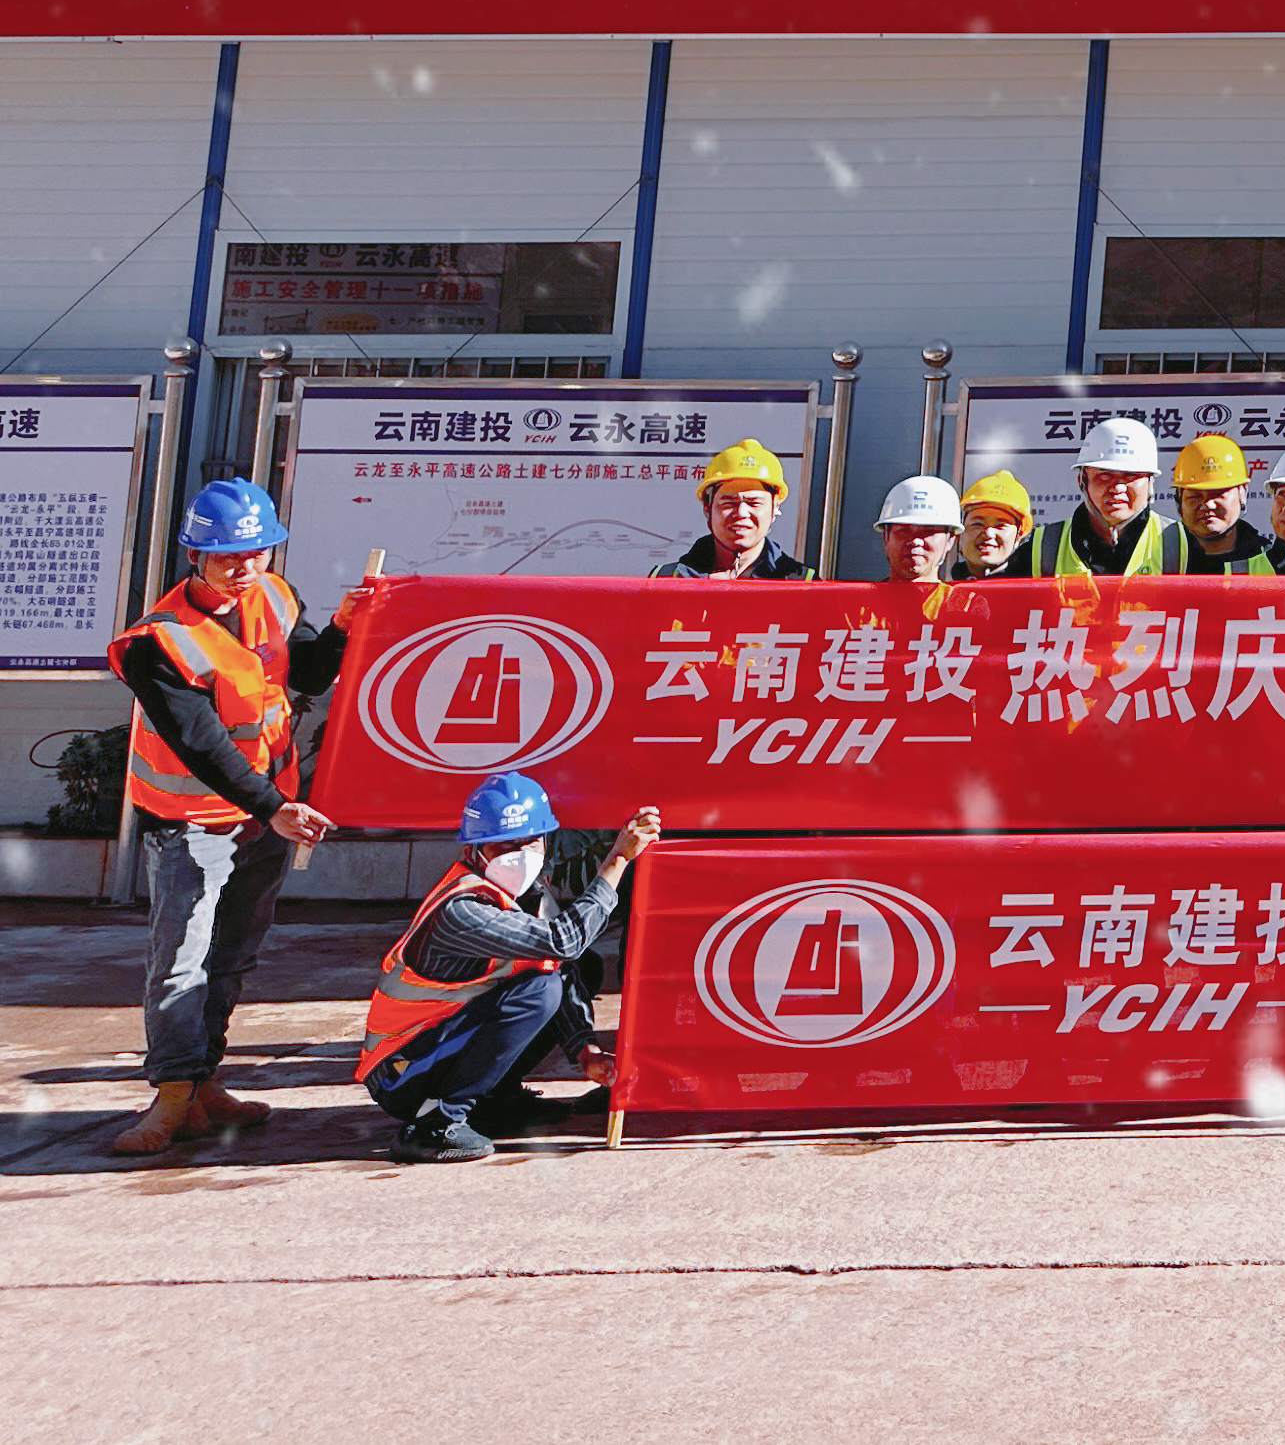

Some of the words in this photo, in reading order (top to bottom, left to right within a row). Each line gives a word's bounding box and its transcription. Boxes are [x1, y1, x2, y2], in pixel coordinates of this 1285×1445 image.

[0, 407, 41, 439] 速
[373, 410, 513, 443] 云南建投
[569, 411, 708, 444] 云永高速
[647, 623, 978, 705] 云南建投
[707, 719, 898, 766] YCIH
[1055, 983, 1246, 1034] YCIH
